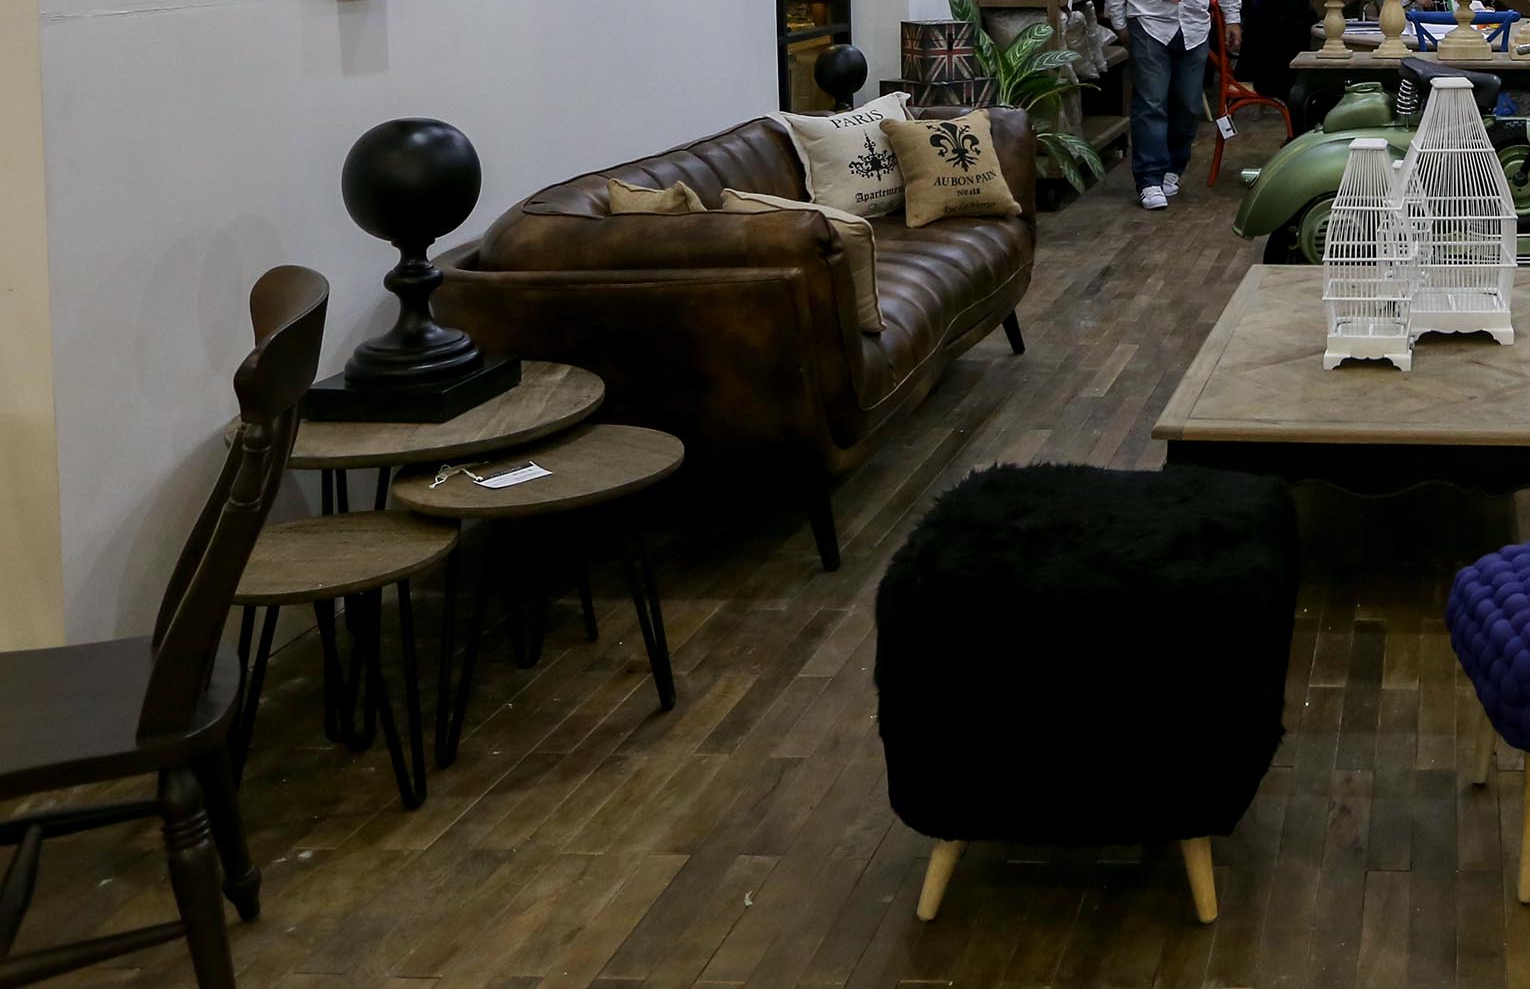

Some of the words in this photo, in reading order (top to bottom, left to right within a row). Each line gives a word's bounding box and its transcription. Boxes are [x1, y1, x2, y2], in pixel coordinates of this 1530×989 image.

[829, 108, 884, 129] PARIS
[934, 176, 950, 187] AU
[951, 175, 974, 187] BON
[975, 170, 997, 184] PAIN
[855, 185, 905, 203] Apartemen
